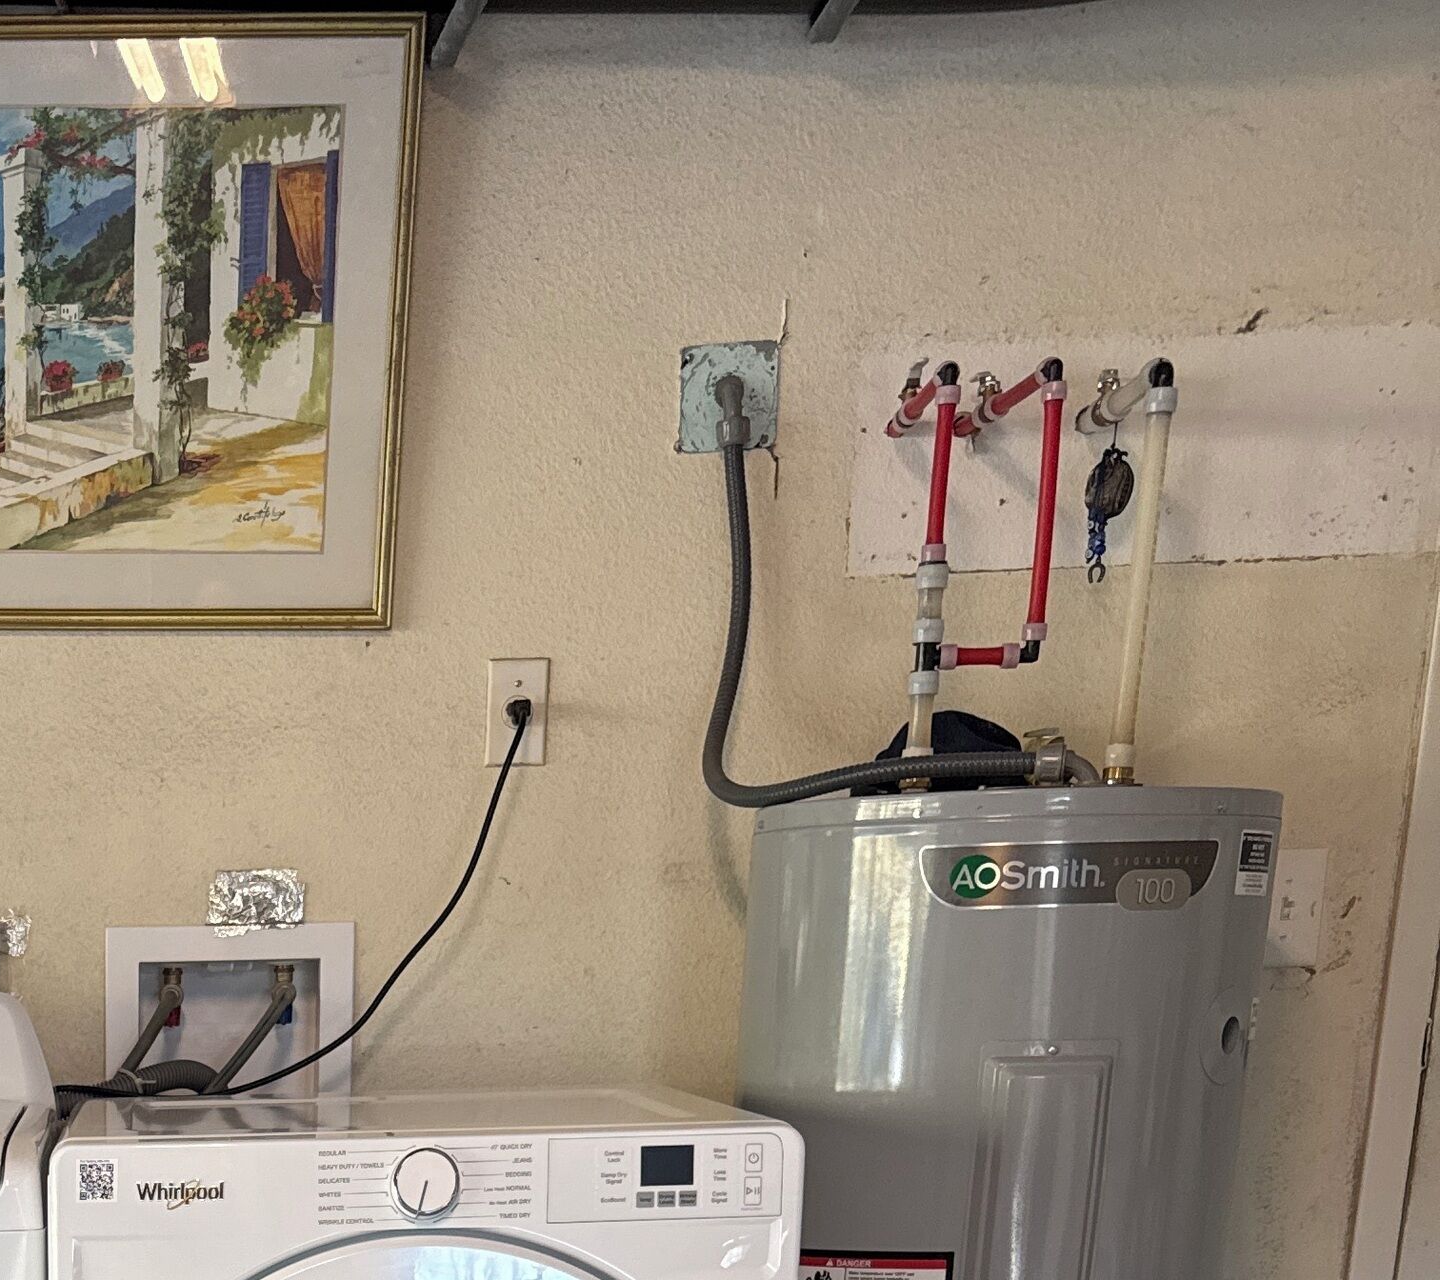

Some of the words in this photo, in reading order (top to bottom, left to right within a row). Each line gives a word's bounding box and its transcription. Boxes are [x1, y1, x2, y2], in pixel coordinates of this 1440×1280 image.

[1135, 877, 1176, 904] 100
[136, 1180, 225, 1205] Whirlpool
[836, 1259, 871, 1267] DANGER
